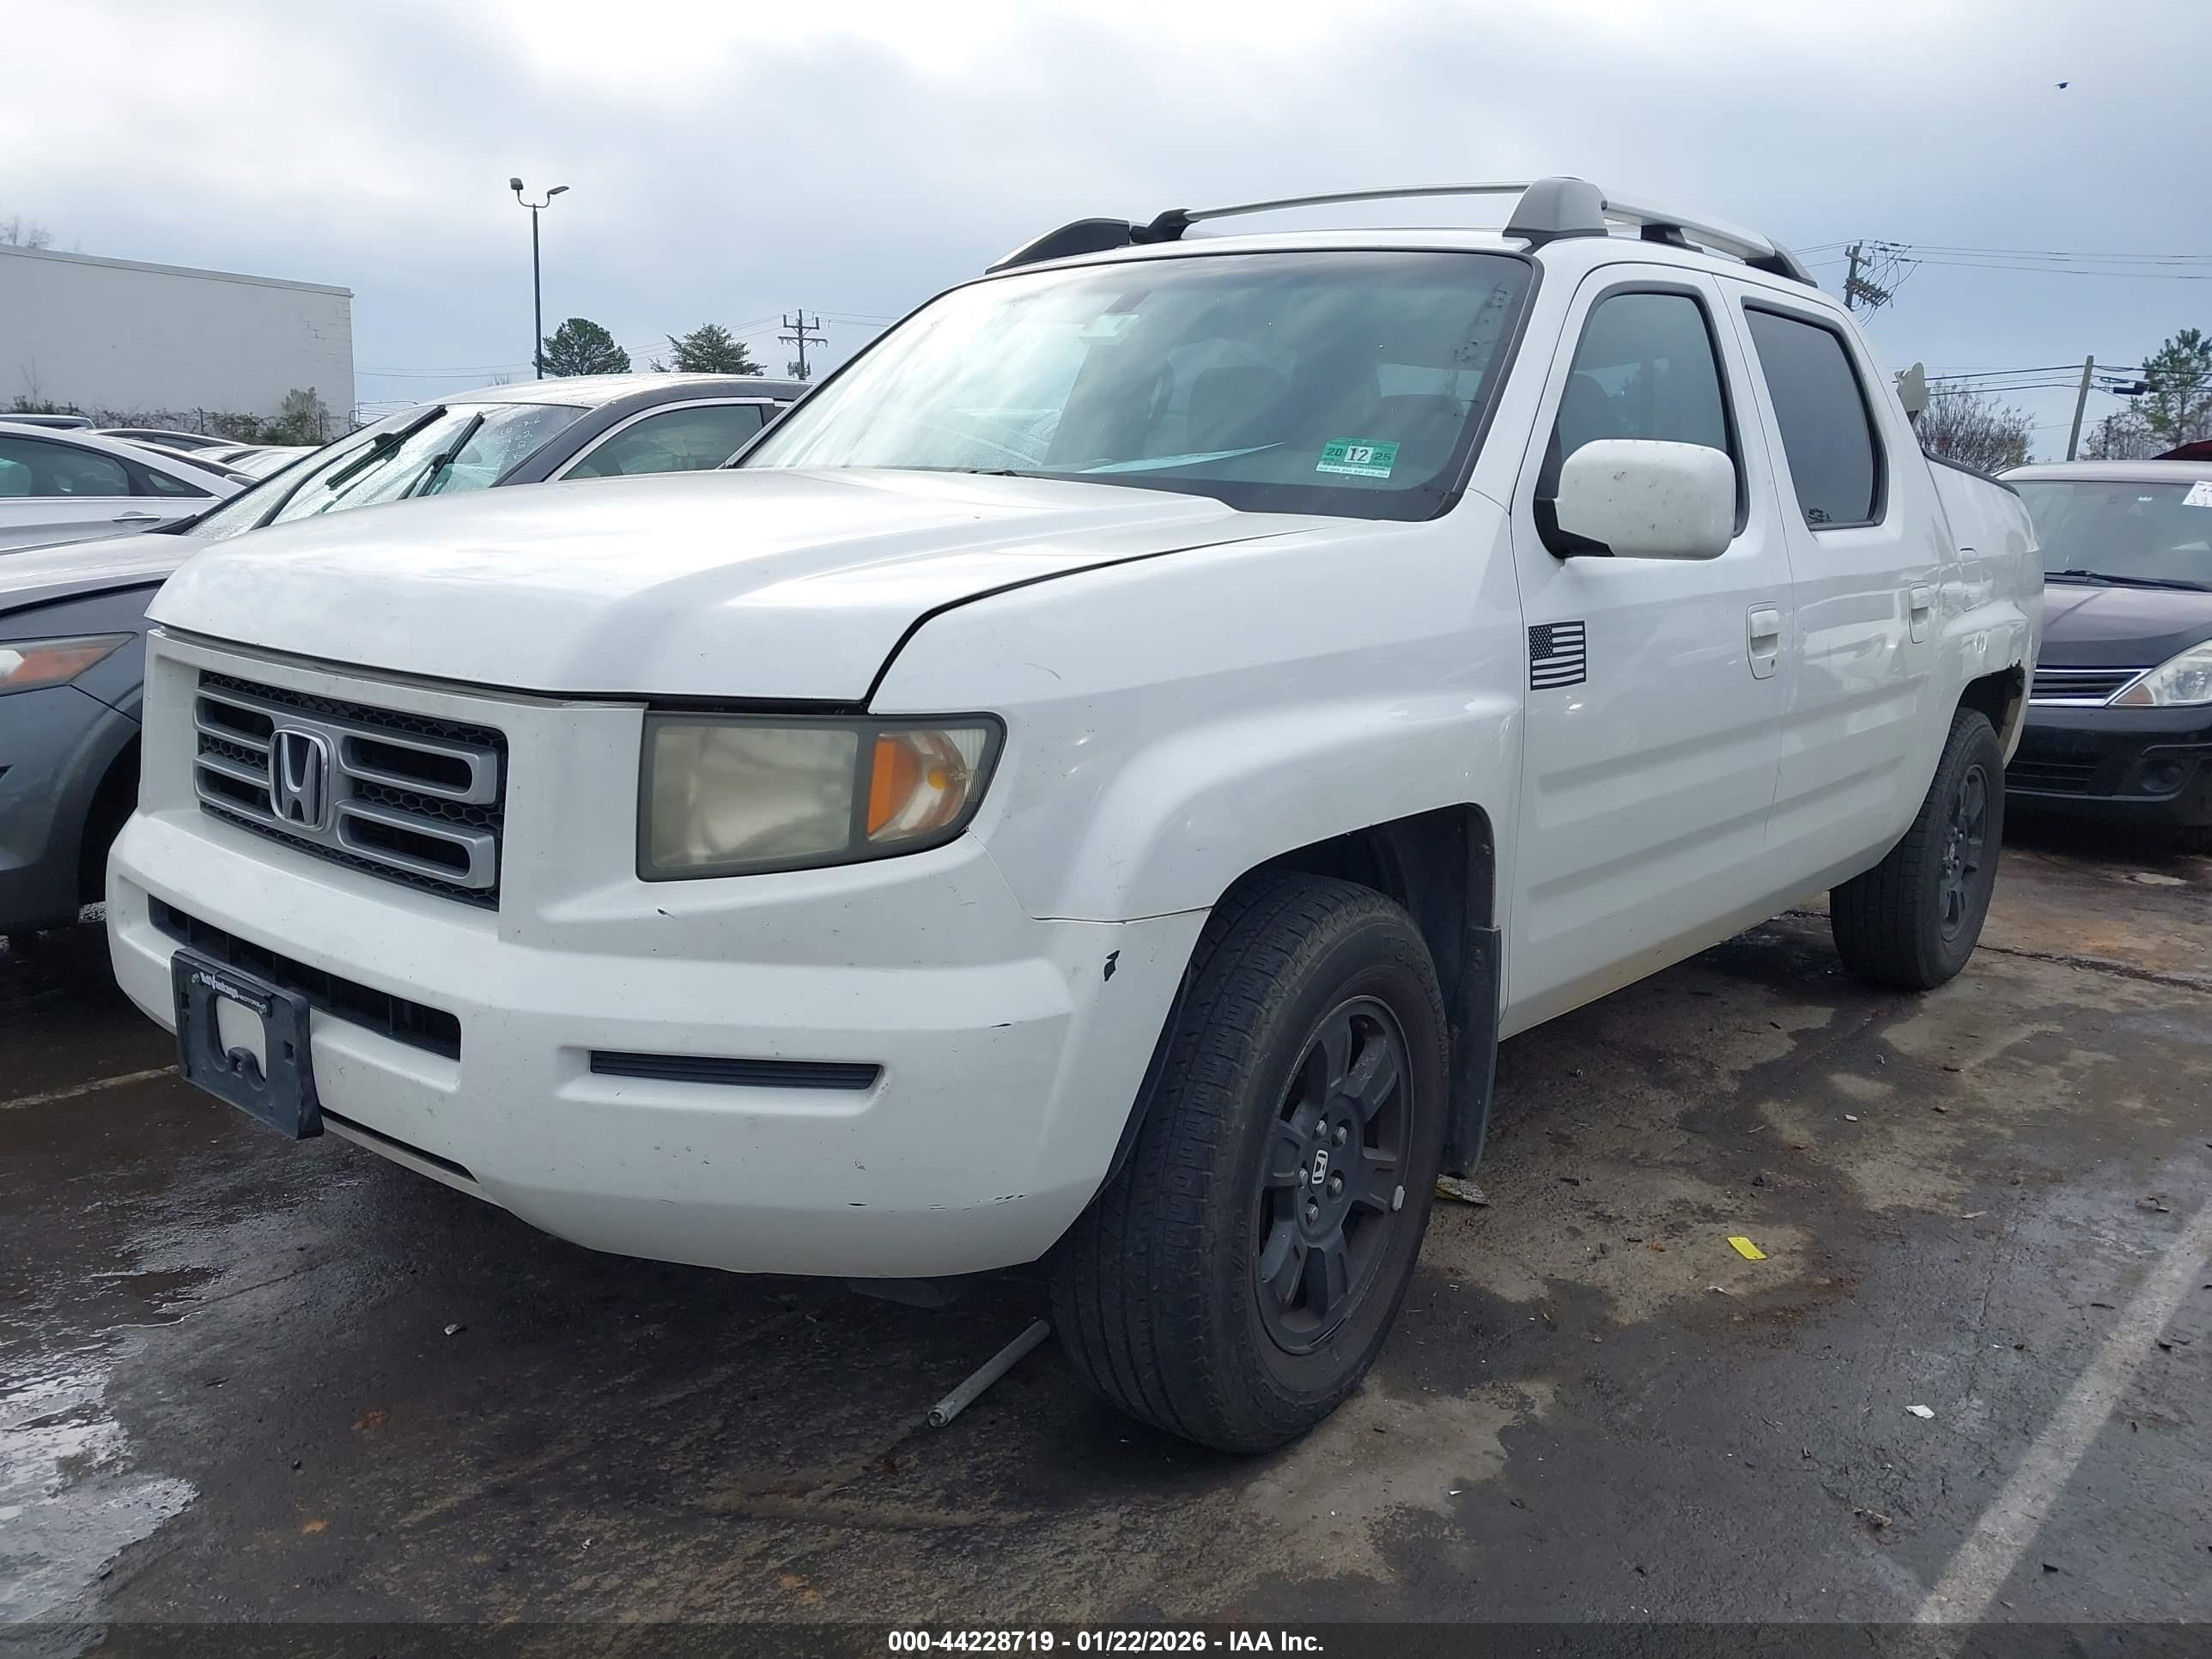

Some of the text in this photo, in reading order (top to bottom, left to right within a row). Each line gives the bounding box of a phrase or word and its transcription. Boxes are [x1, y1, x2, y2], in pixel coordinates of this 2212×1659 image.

[1326, 447, 1391, 462] 20 12 25
